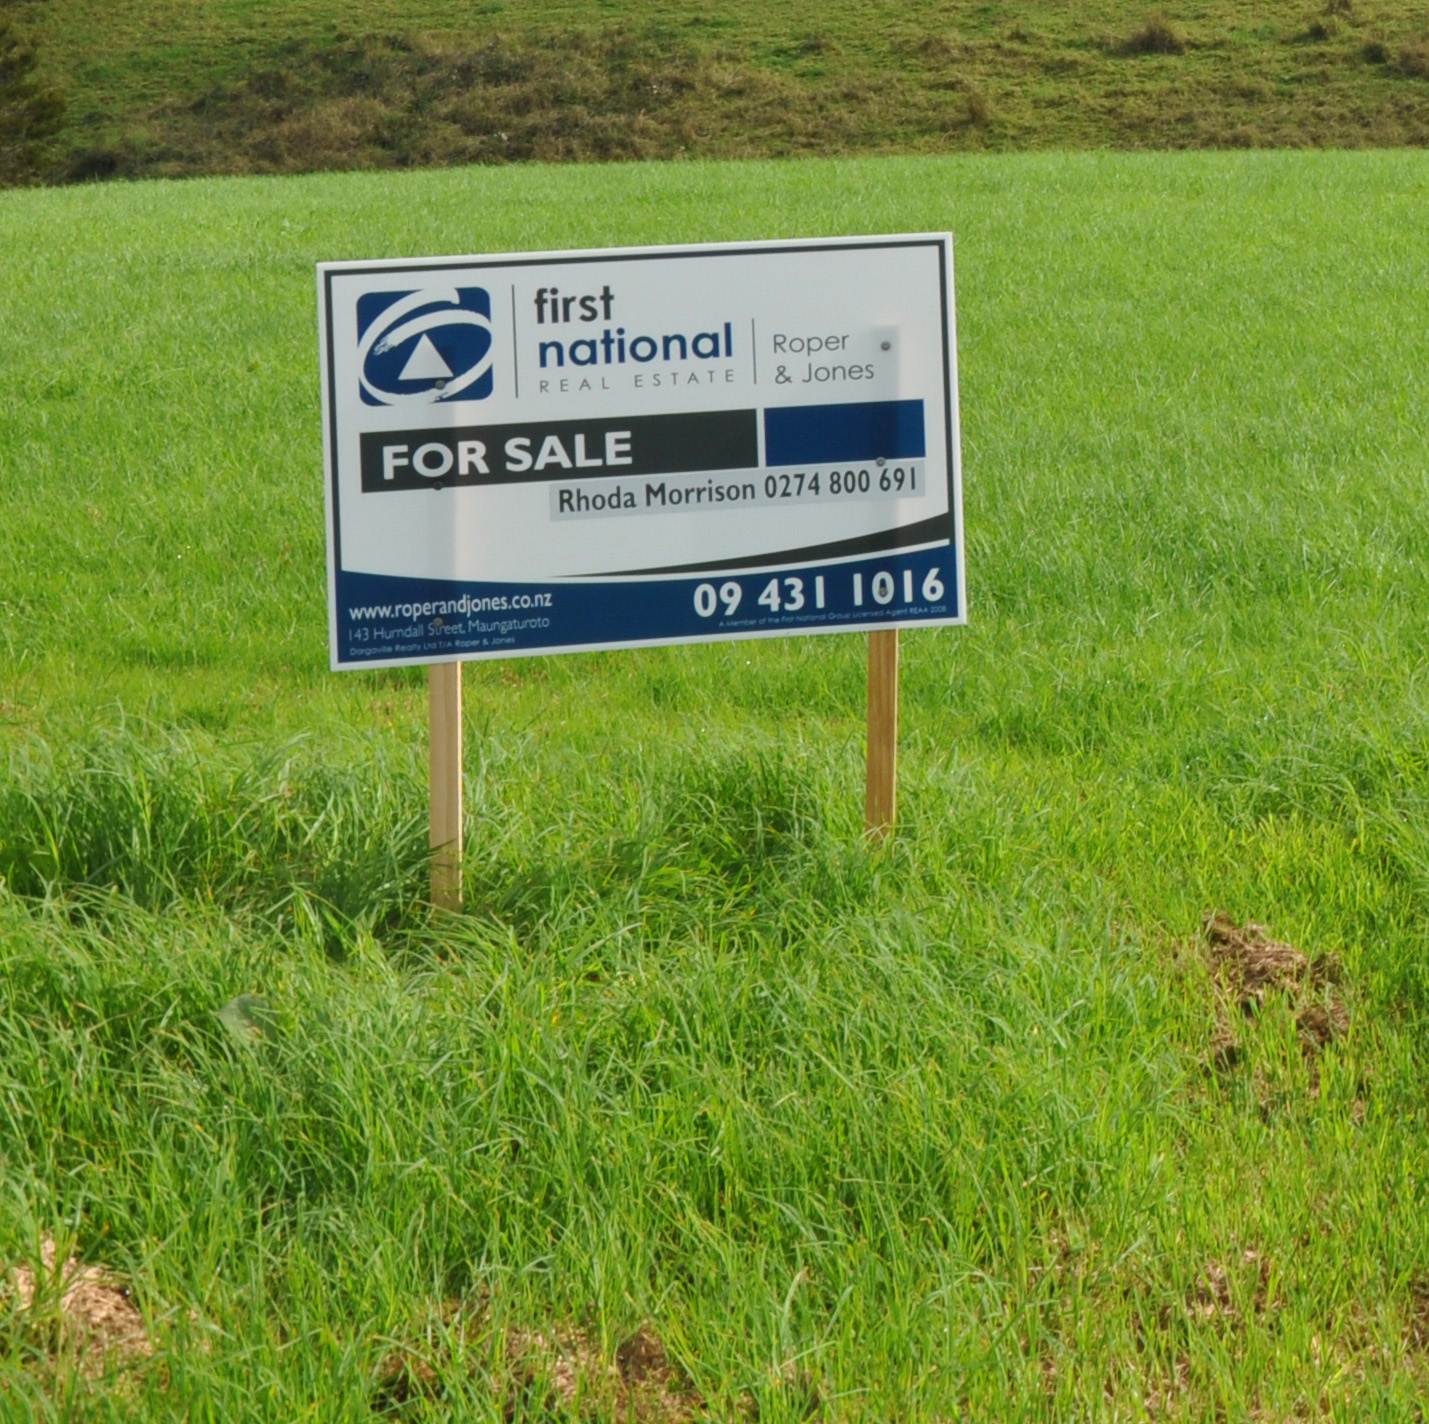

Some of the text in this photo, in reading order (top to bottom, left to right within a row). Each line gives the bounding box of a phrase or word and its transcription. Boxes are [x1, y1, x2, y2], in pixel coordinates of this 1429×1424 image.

[534, 286, 614, 324] first
[539, 322, 733, 368] national
[773, 333, 850, 356] Roper
[539, 369, 735, 393] REAL ESTATE
[775, 362, 875, 384] & Jones
[382, 431, 633, 480] FOR SALE
[559, 467, 916, 513] Rhoda Morrison 0274 800 691
[349, 593, 553, 621] www.roperandjones.co.nz
[693, 568, 945, 617] 09 431 1016
[349, 628, 369, 641] 143
[468, 617, 550, 634] Maungaturoto
